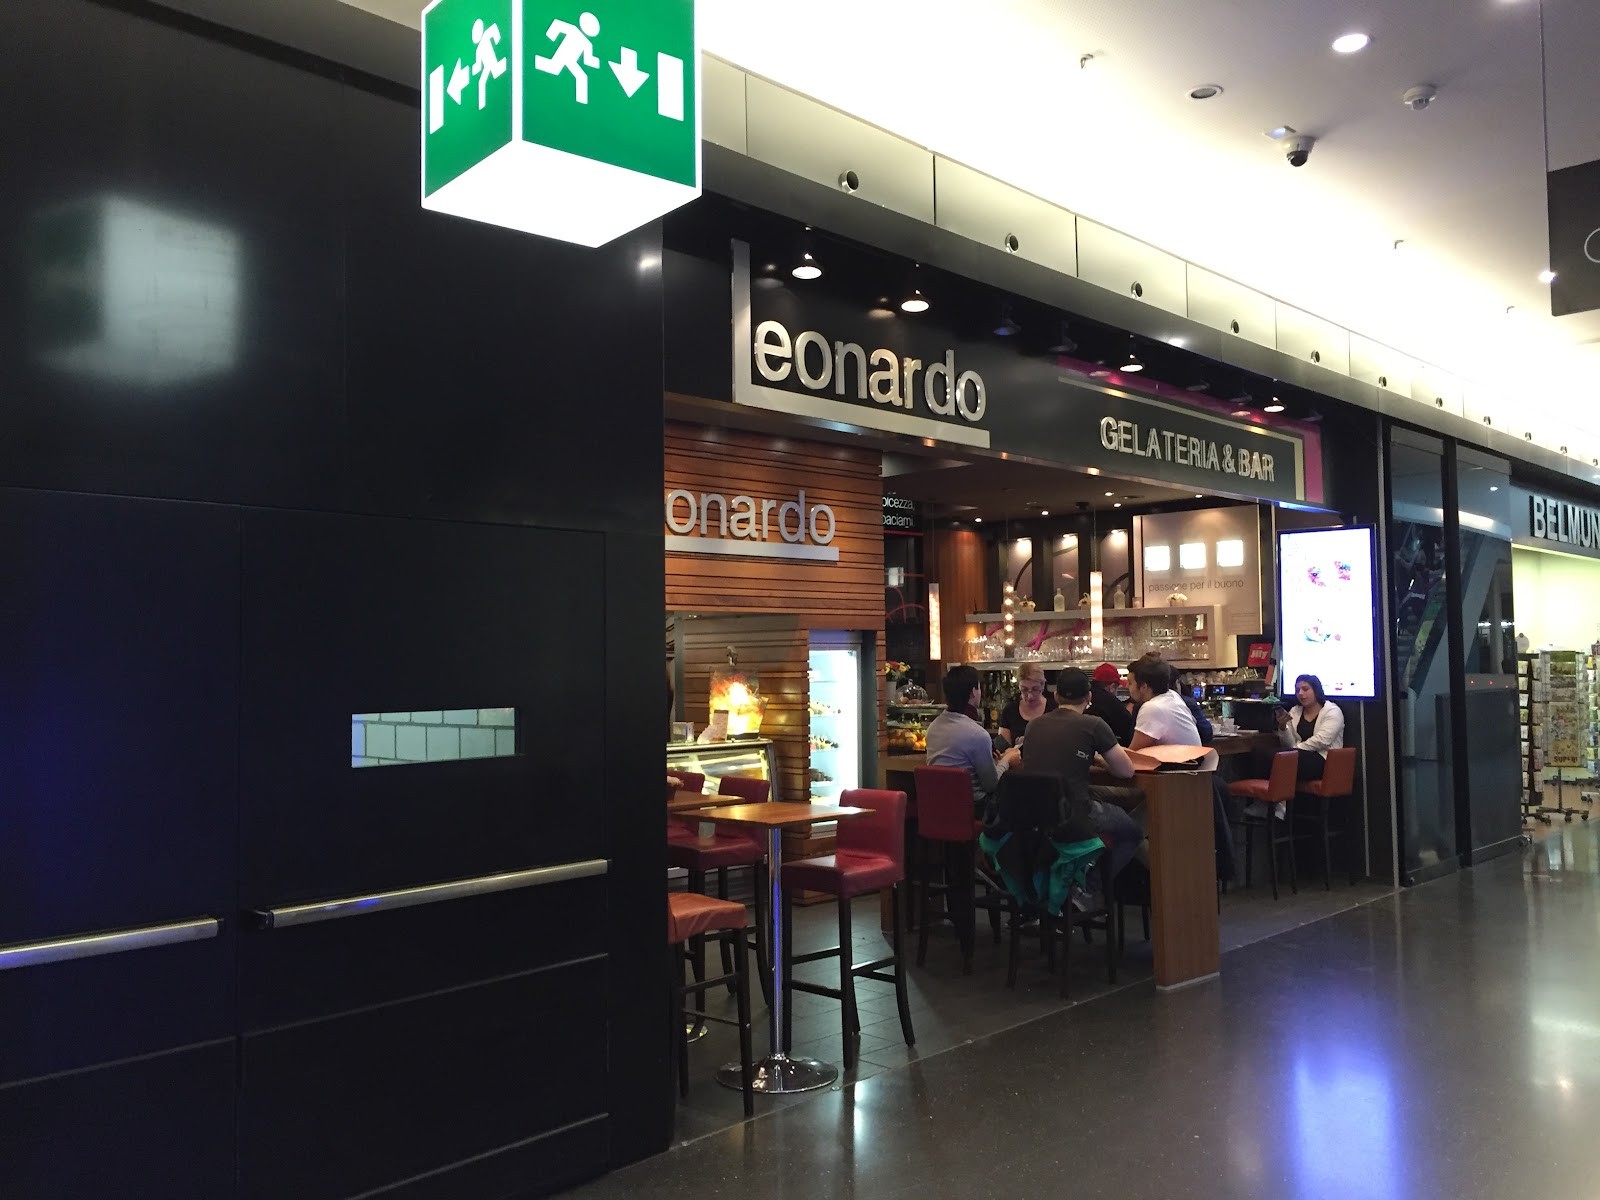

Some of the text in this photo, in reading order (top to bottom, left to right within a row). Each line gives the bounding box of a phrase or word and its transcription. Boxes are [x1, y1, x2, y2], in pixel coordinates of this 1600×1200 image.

[731, 238, 990, 448] Leonardo
[1100, 416, 1275, 482] GELATERIA & BAR
[1148, 581, 1188, 593] passione
[1189, 580, 1205, 592] per
[1214, 579, 1244, 590] buono
